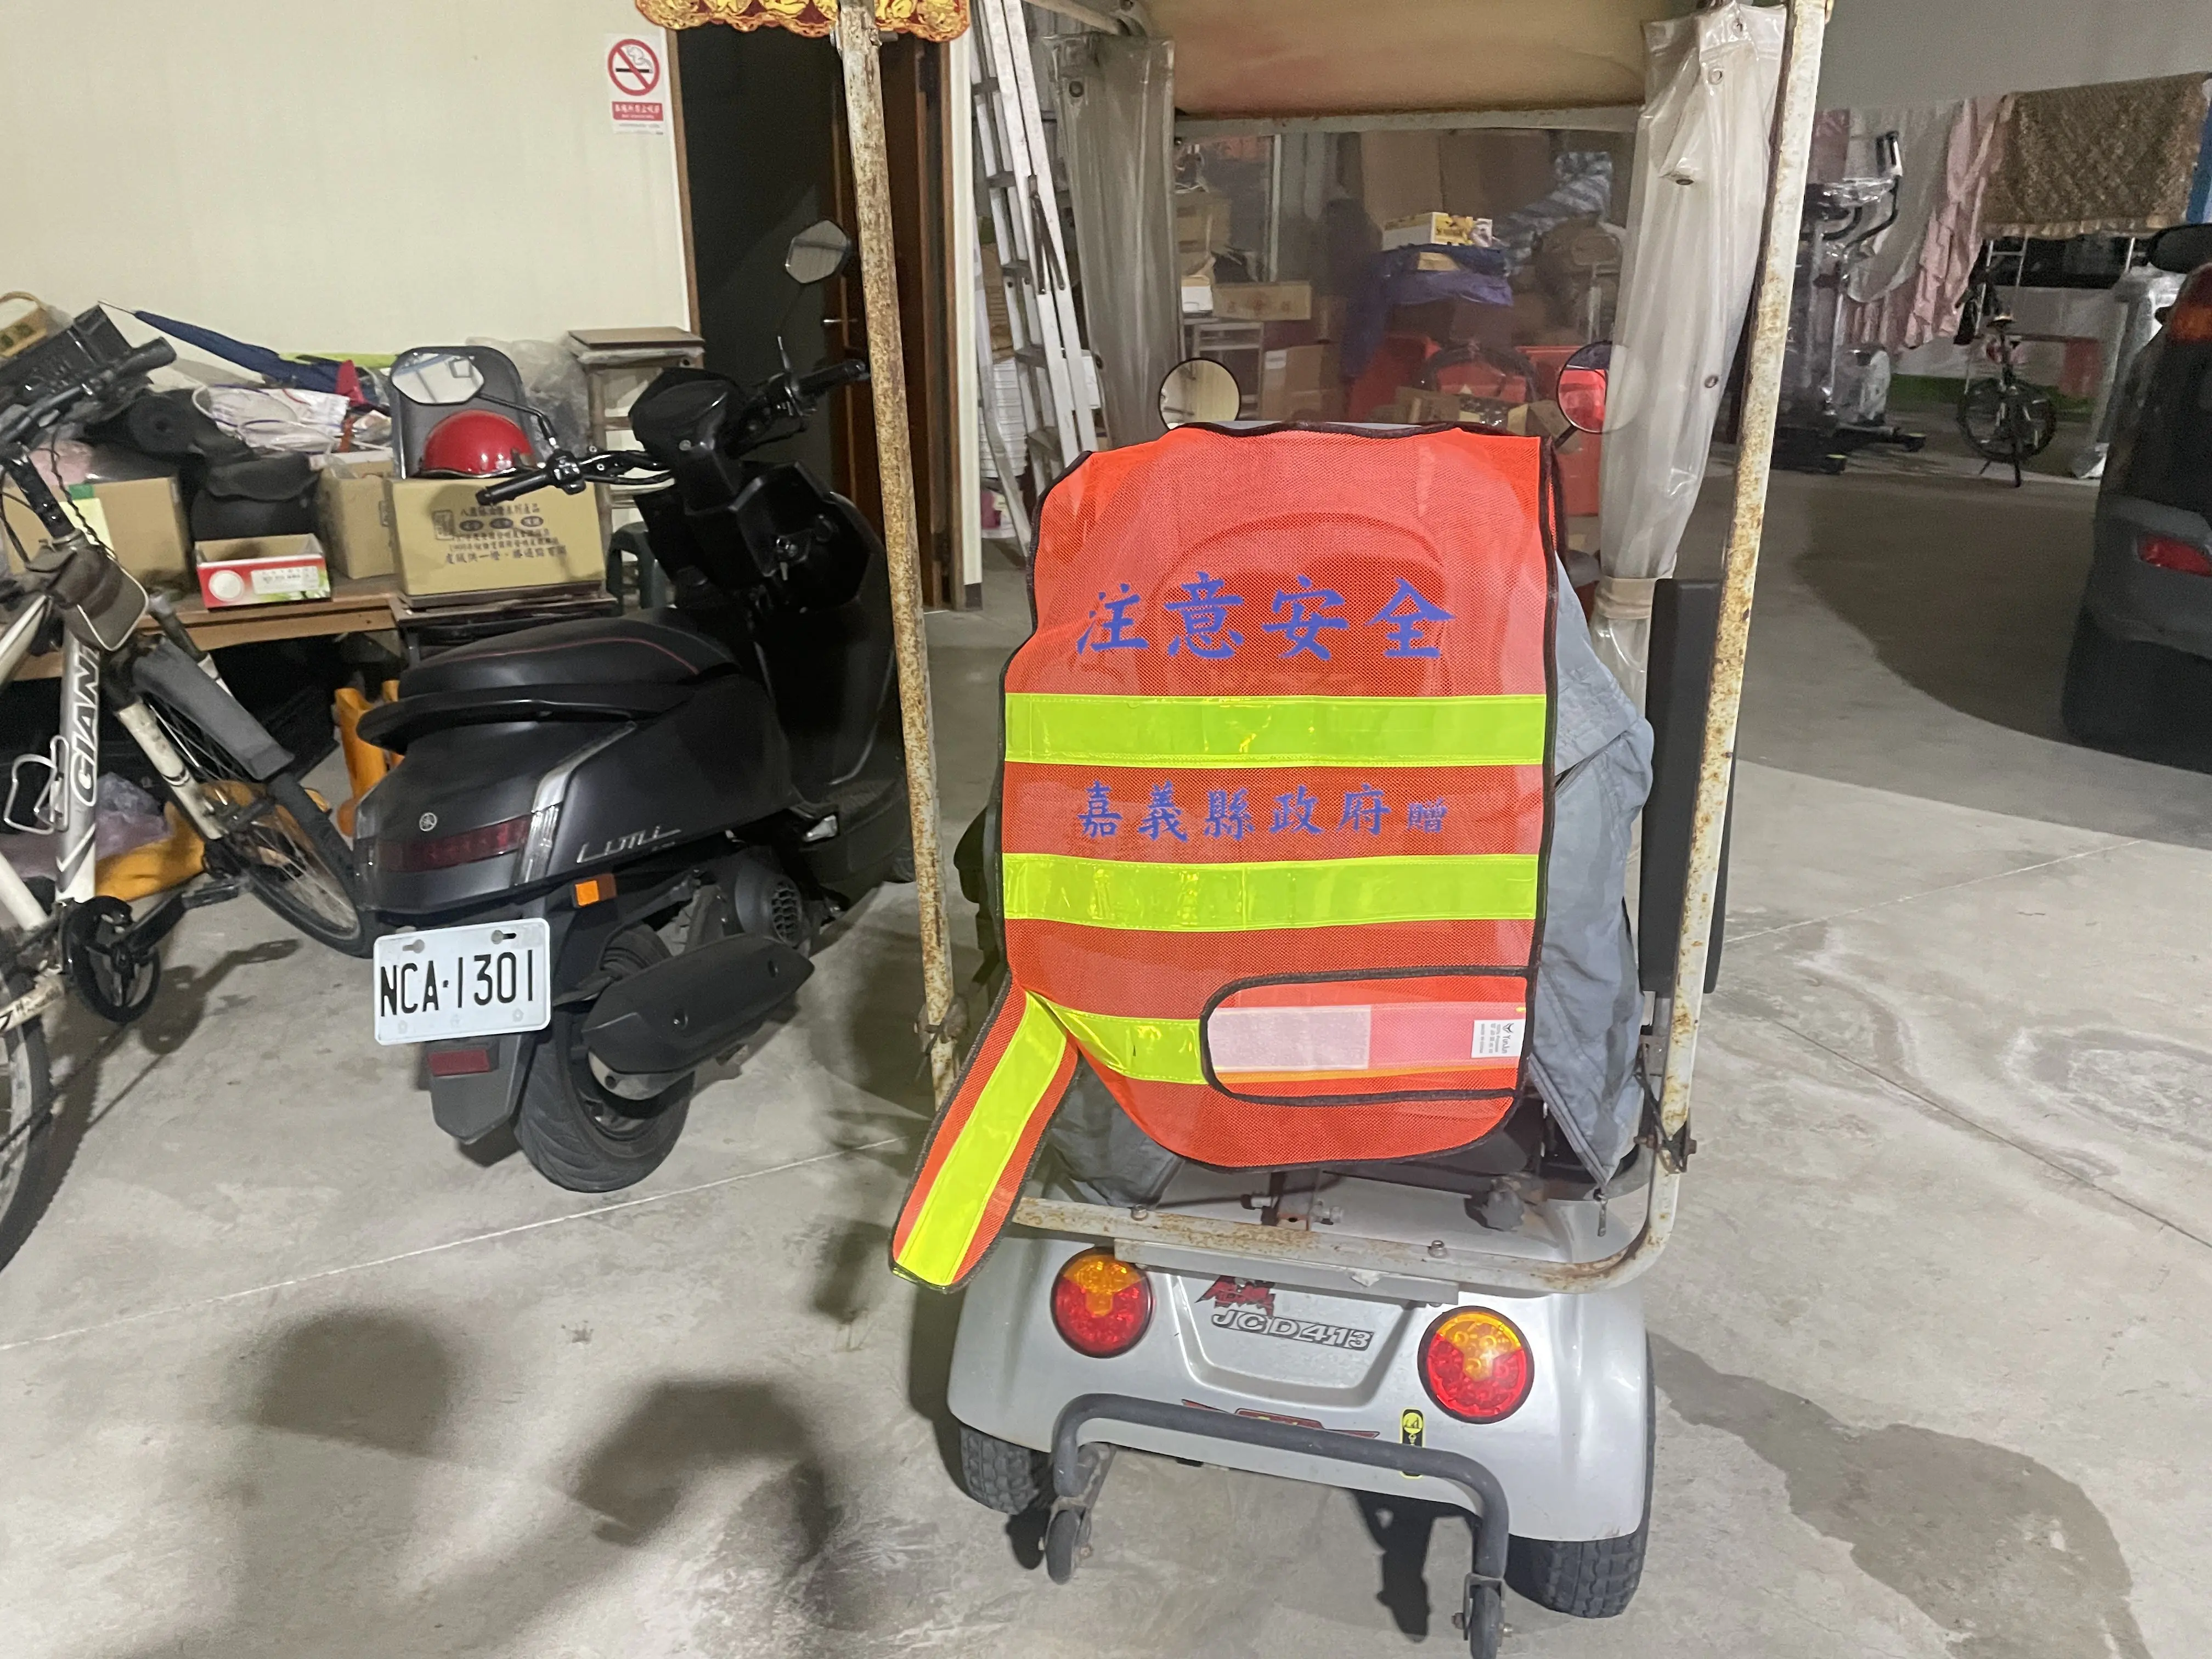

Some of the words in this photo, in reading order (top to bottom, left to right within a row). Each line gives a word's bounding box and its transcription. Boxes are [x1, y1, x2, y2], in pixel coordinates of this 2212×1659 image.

[1076, 572, 1455, 661] 注意安全
[1211, 1309, 1374, 1351] JCD413
